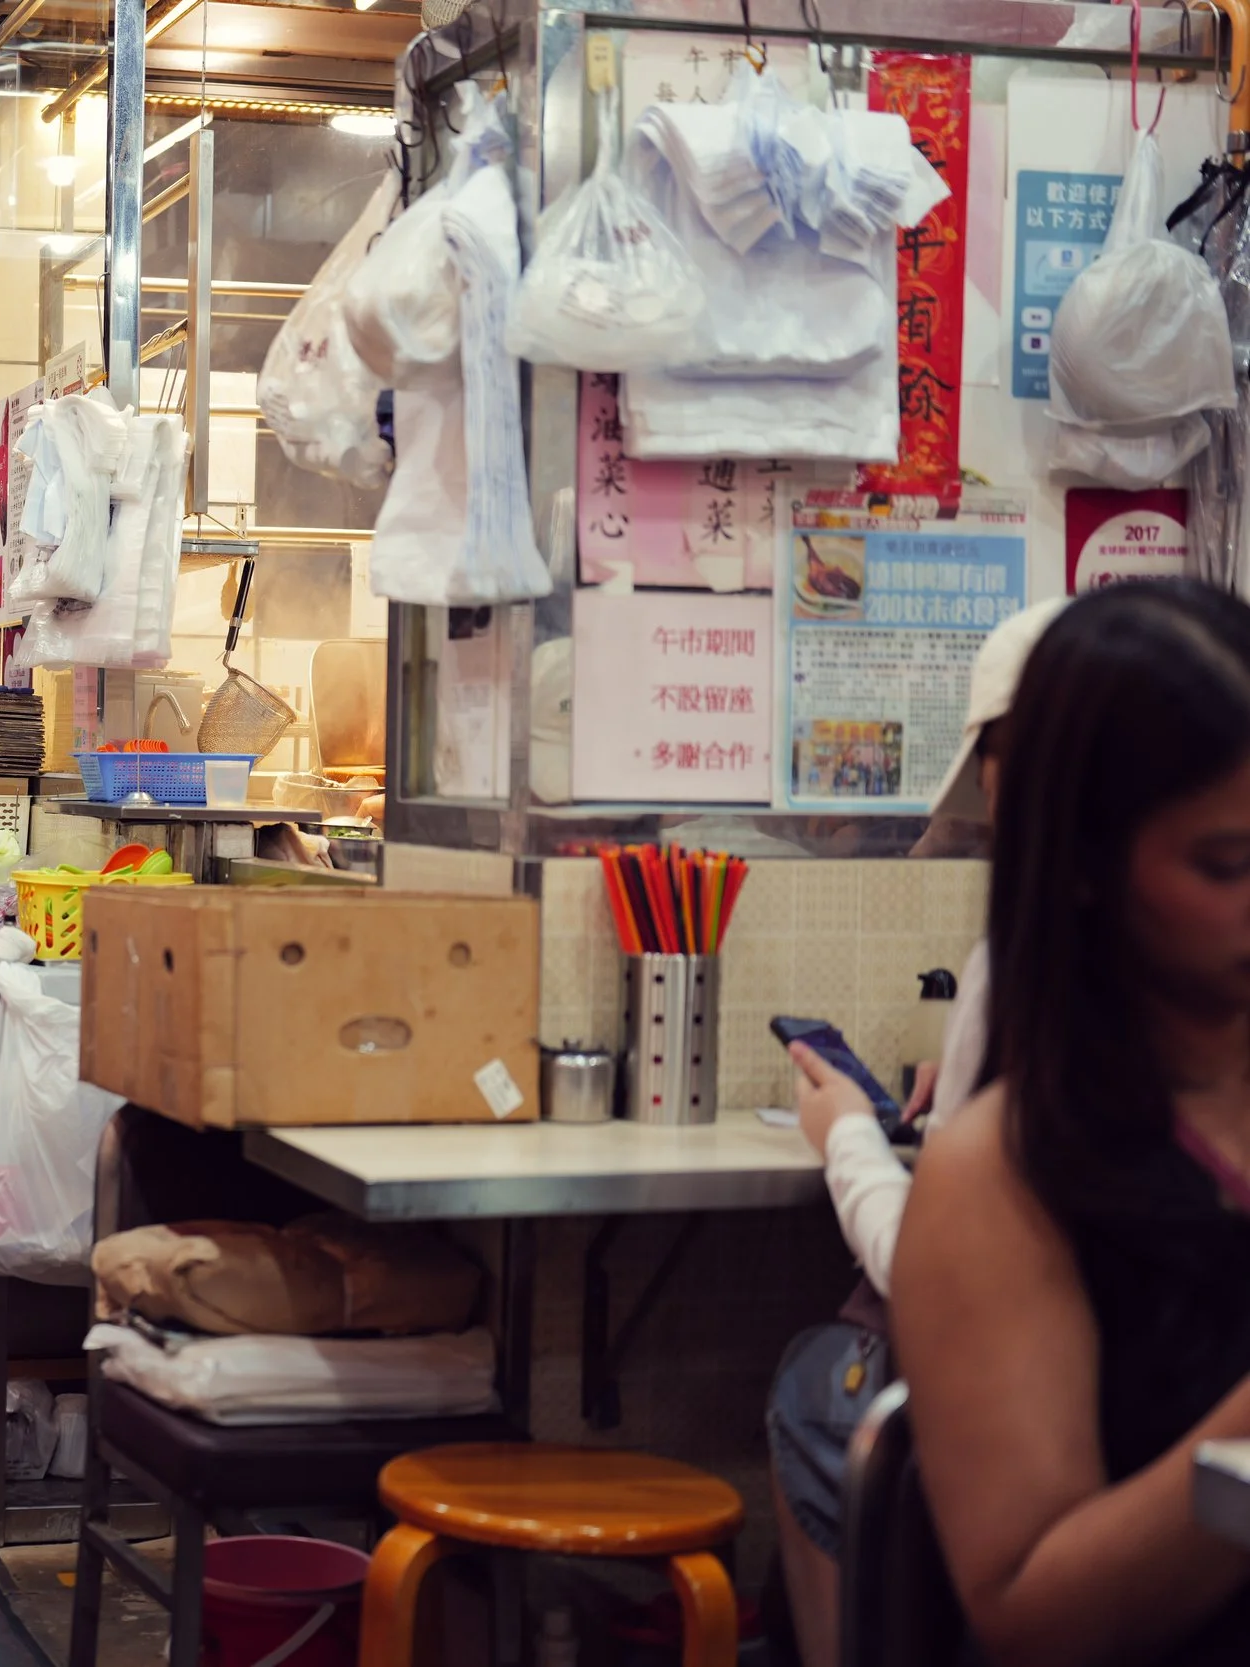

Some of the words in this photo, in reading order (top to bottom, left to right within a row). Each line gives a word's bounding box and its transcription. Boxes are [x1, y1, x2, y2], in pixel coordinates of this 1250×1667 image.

[1124, 526, 1161, 542] 2017
[652, 626, 756, 657] 午市期間
[651, 684, 756, 714] 不設留座
[652, 741, 754, 771] 多謝合作
